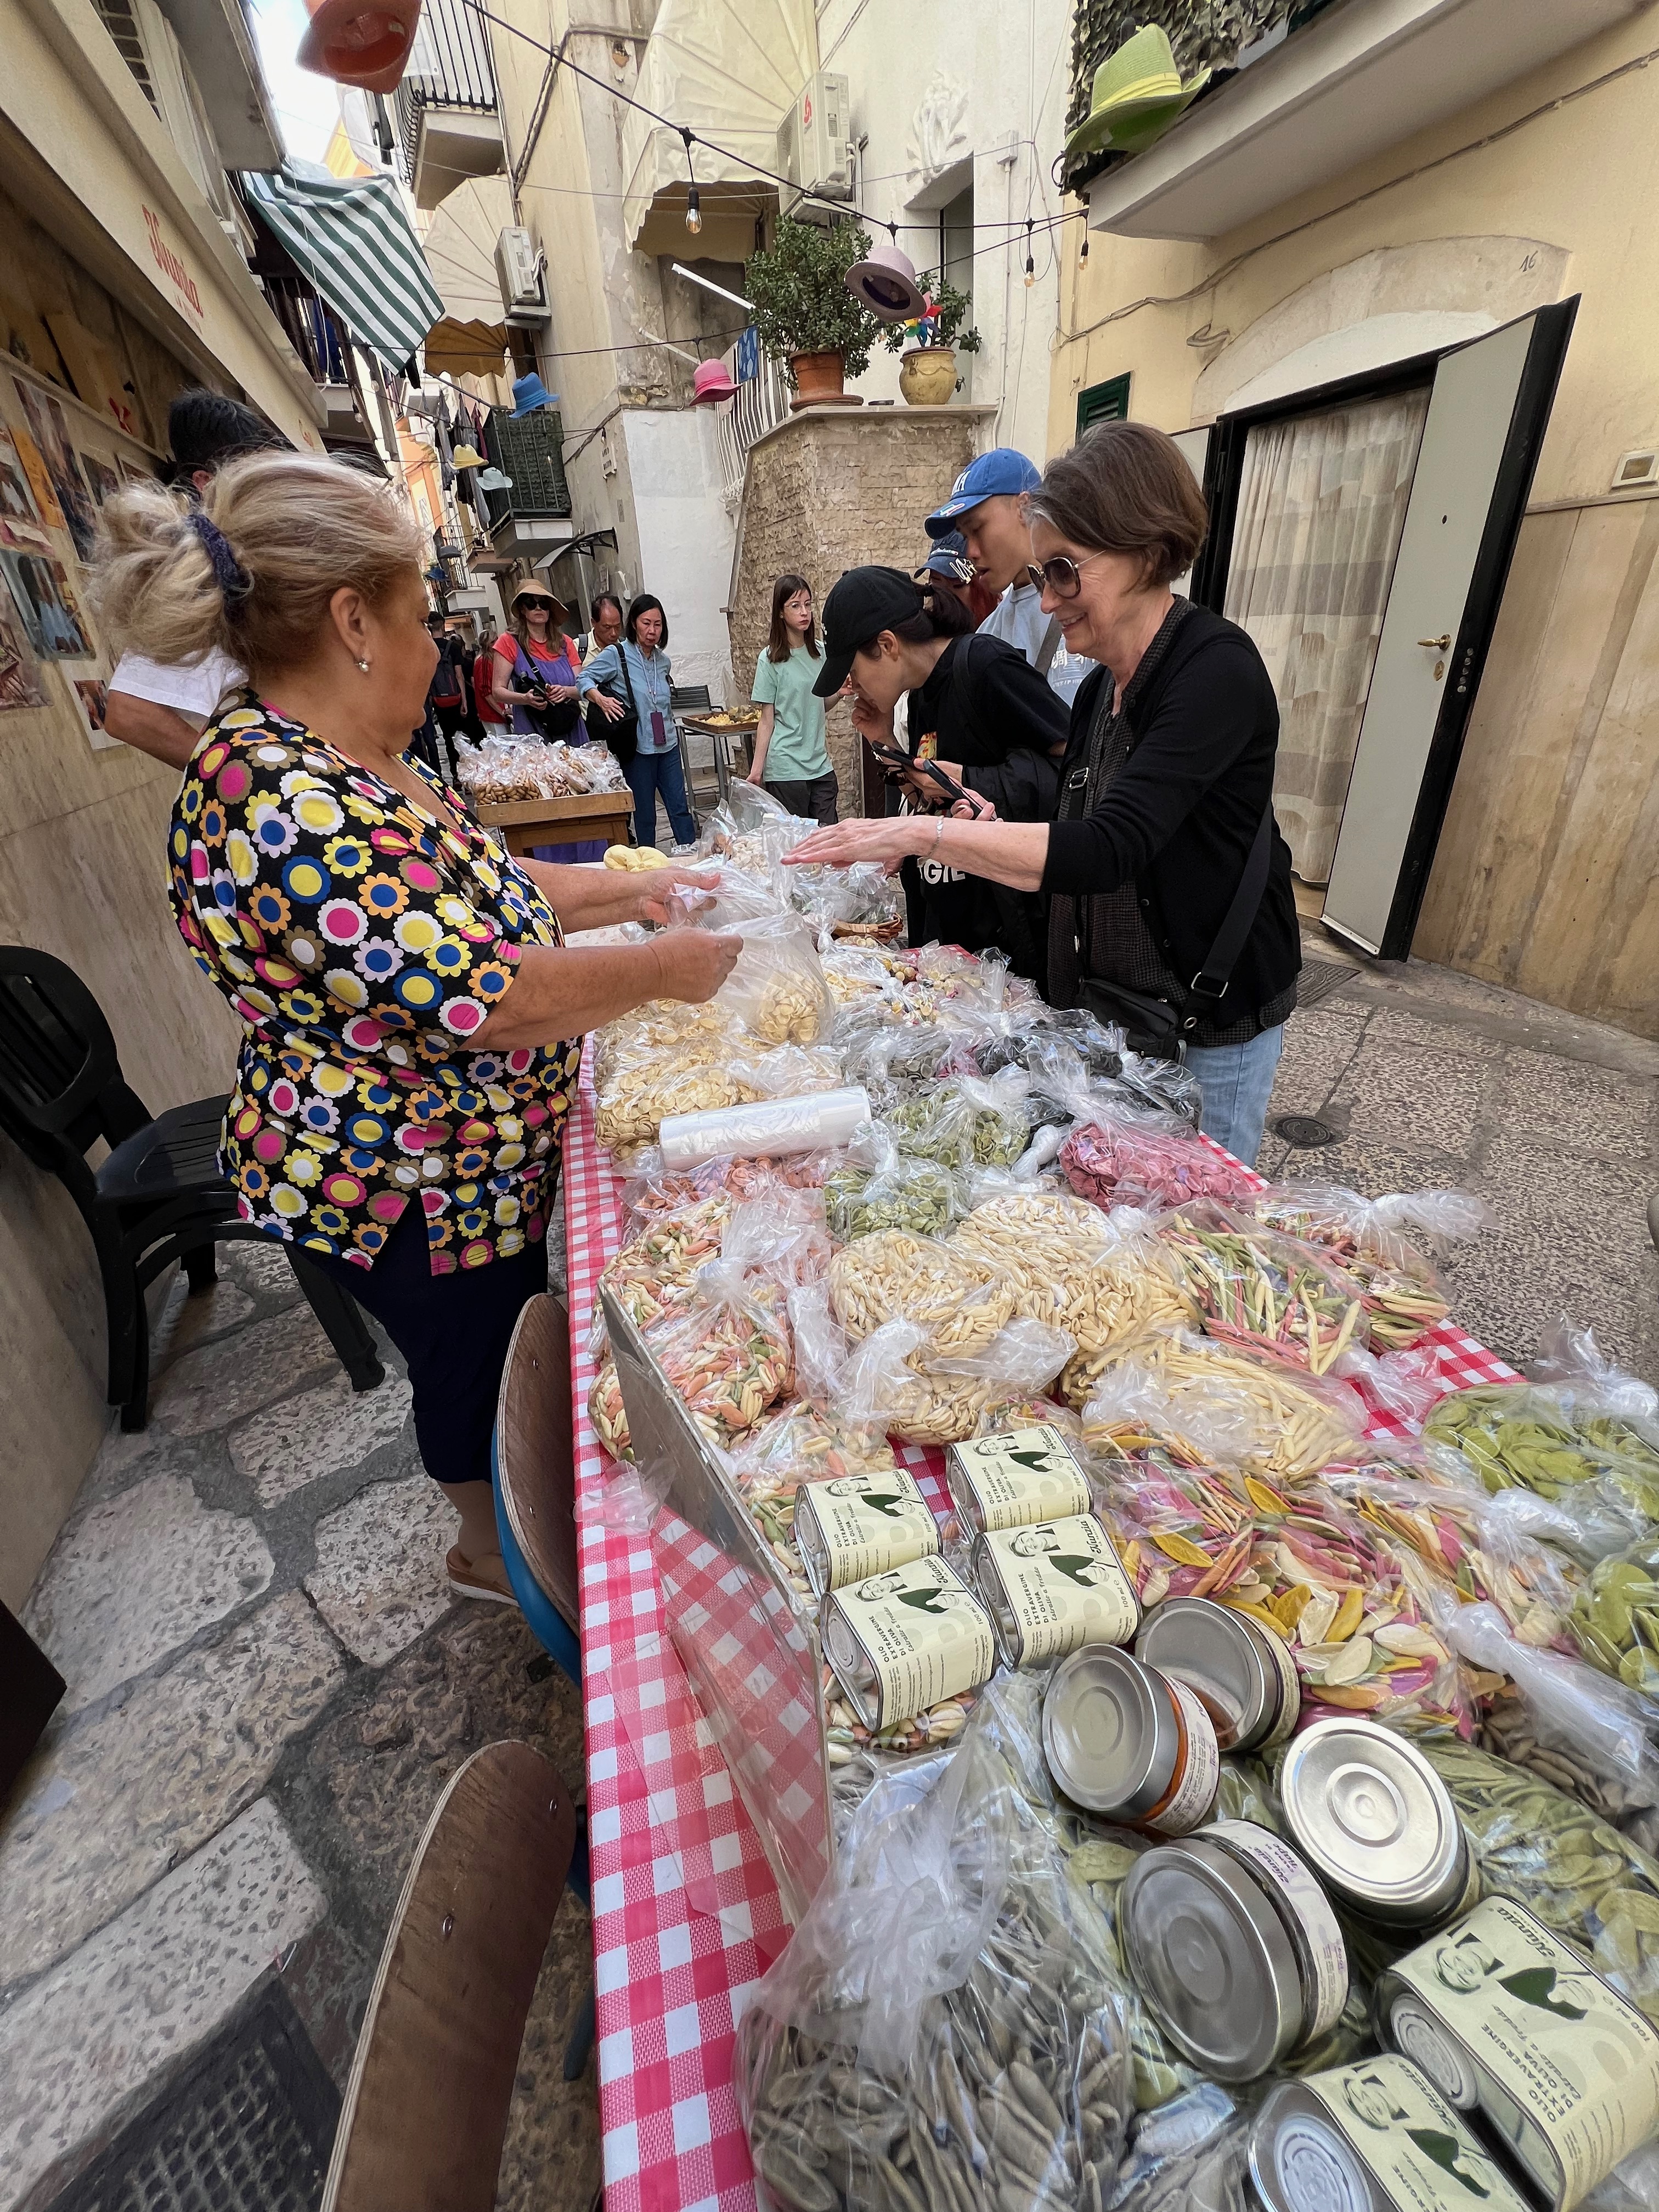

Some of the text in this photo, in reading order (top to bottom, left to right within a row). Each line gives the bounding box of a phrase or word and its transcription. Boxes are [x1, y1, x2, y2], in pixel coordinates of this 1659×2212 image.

[1519, 250, 1538, 272] 16
[1081, 1521, 1101, 1554] Nunzia
[924, 1559, 948, 1583] Nunzia
[1018, 1573, 1041, 1624] EXTRAVERGINE
[1035, 1592, 1049, 1623] DI OLIVA
[974, 1615, 983, 1624] 100
[1023, 1609, 1032, 1626] OLIO
[868, 1616, 898, 1660] EXTRAVERGINE
[888, 1628, 901, 1646] OLIVA
[878, 1646, 889, 1662] OLIO
[1497, 1908, 1555, 1957] Nunzia
[1631, 2022, 1650, 2042] 100
[1481, 2023, 1565, 2116] EXTRAVERGINE
[1524, 2051, 1557, 2088] OLIVA
[1528, 2089, 1555, 2123] OLIO
[1561, 2094, 1573, 2109] DI
